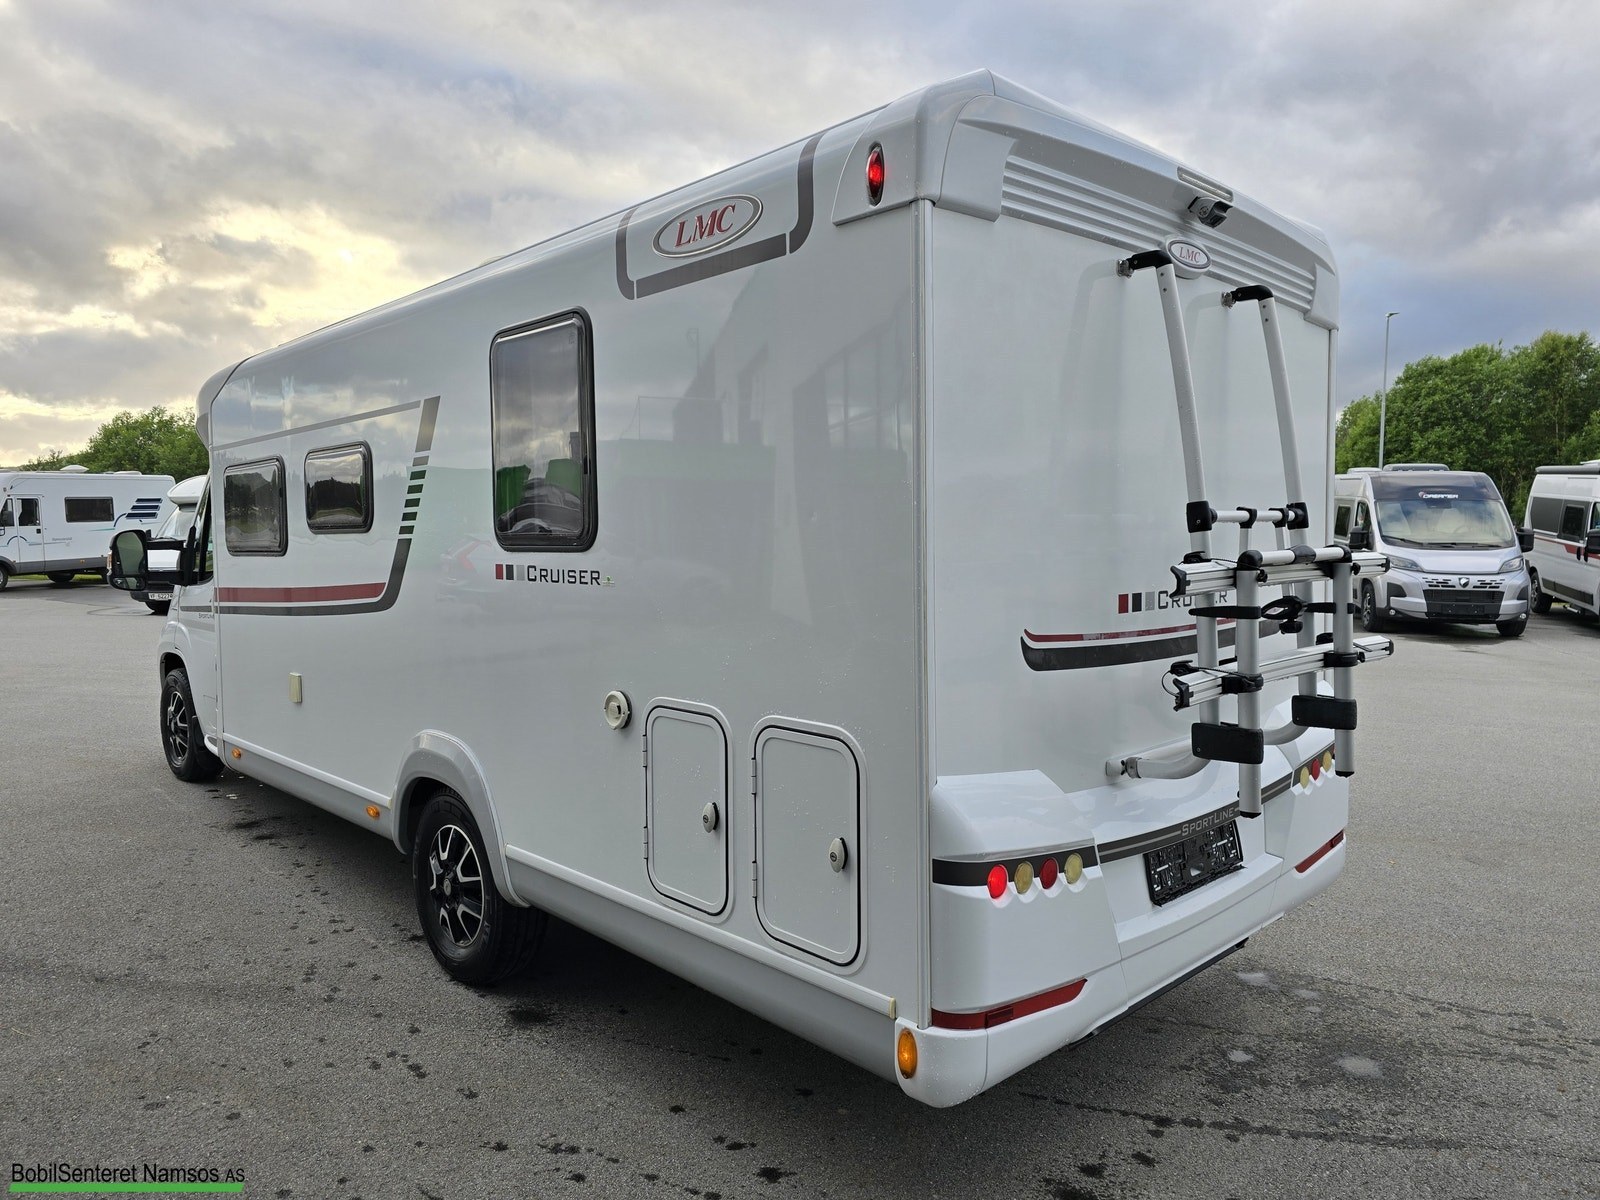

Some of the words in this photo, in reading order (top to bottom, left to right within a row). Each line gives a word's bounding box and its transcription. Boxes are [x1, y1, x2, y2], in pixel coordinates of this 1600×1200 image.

[674, 203, 736, 248] LMC
[1179, 246, 1200, 263] LMC
[527, 564, 601, 586] CRUISER
[1157, 590, 1228, 609] CRUR
